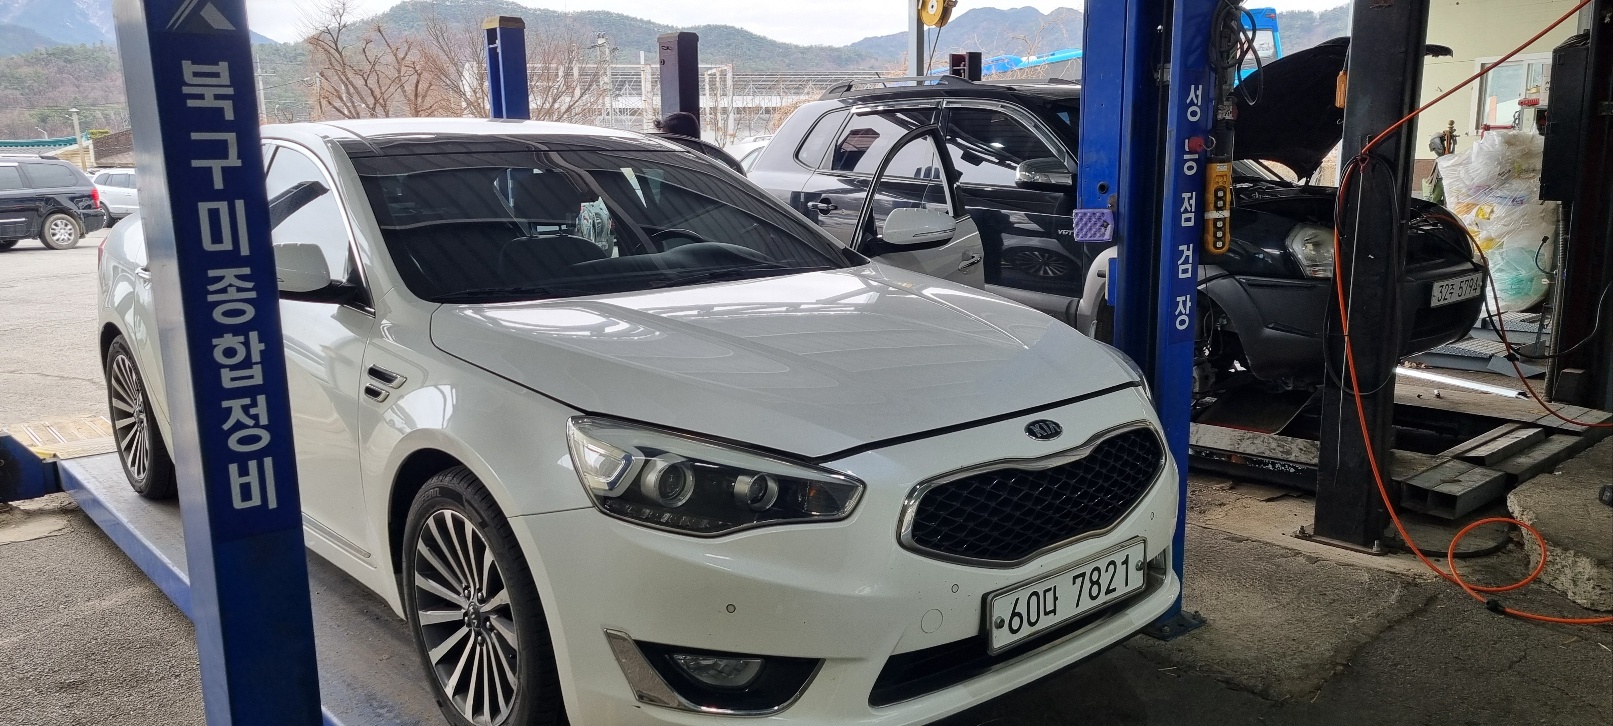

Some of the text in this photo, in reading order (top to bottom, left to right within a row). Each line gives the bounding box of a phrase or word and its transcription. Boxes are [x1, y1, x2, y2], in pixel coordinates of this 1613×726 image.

[181, 60, 278, 510] 북구미종합정비
[1437, 276, 1479, 302] 32주 5794
[1029, 421, 1061, 438] KIA
[1008, 553, 1130, 635] 60다 7821
